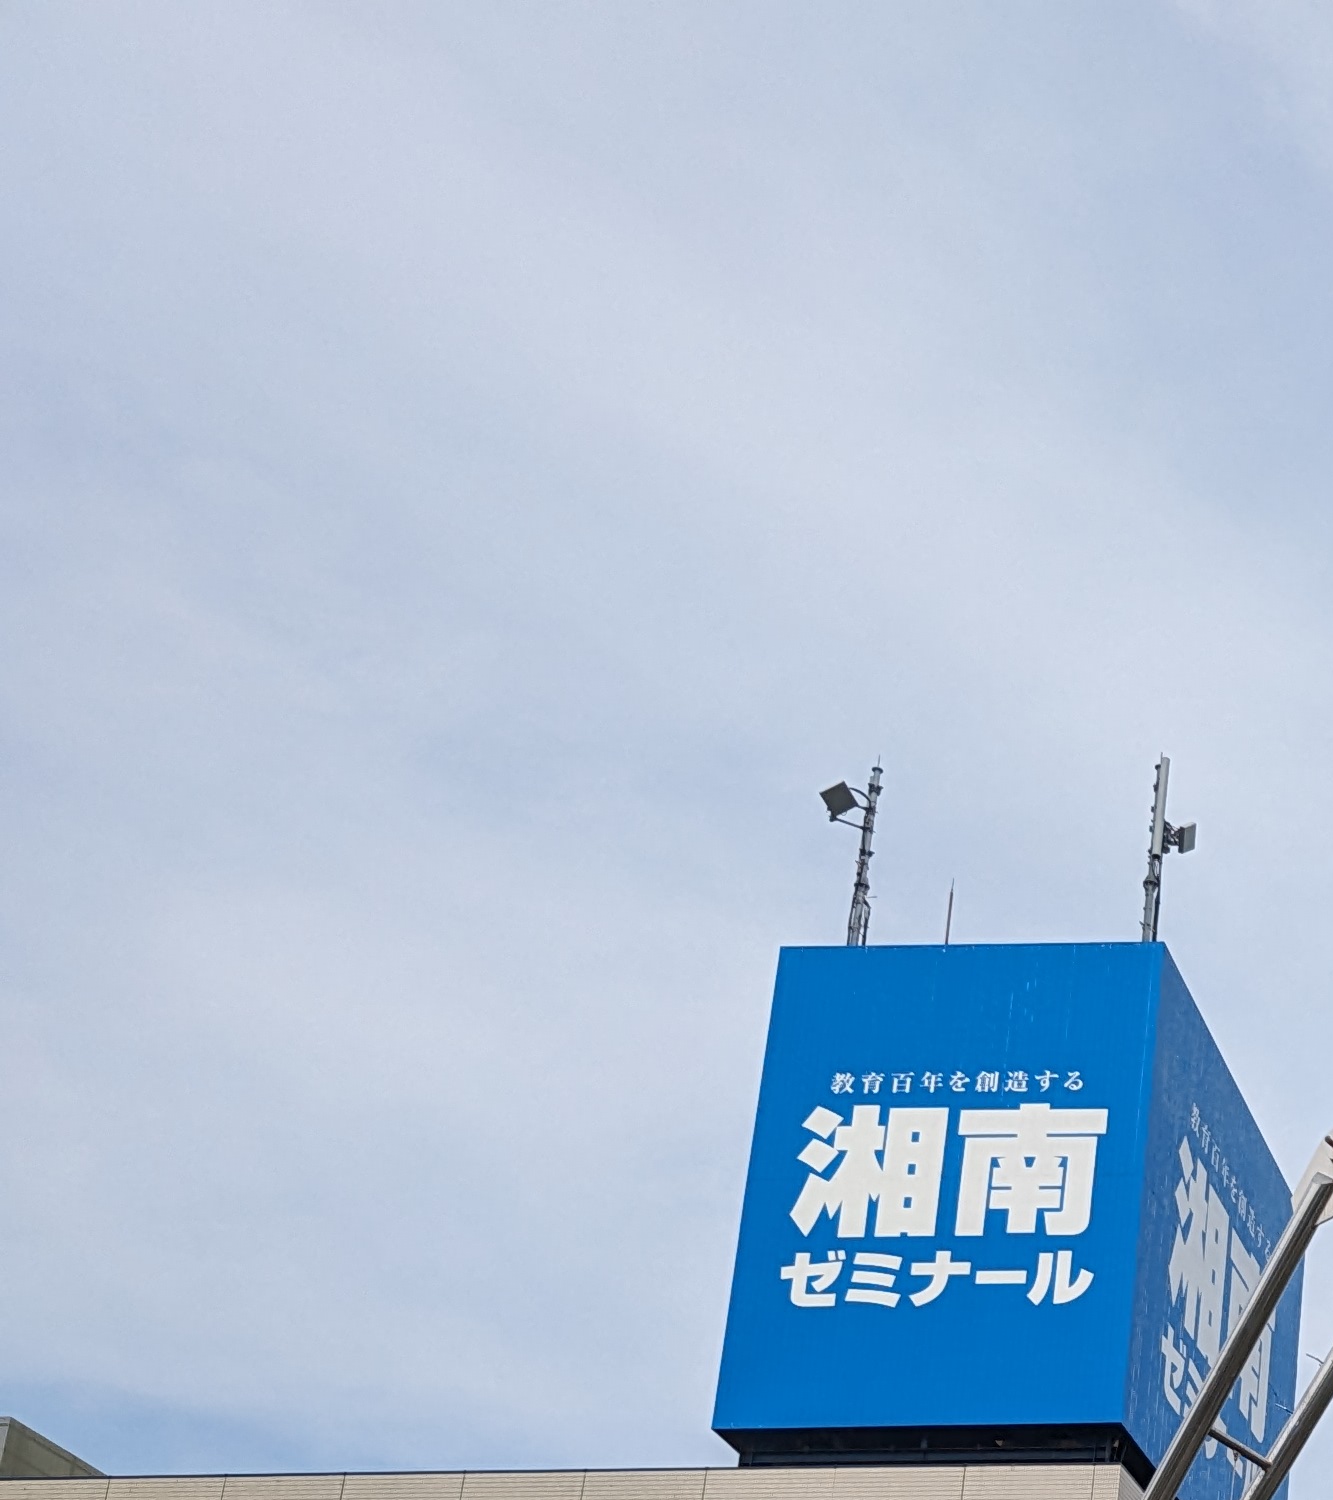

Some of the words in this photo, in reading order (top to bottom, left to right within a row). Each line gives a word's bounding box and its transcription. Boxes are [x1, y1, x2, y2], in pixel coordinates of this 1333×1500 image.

[830, 1069, 1084, 1094] 教育百年を創造する
[789, 1102, 1109, 1238] 湘南
[780, 1249, 1095, 1308] ゼミナール
